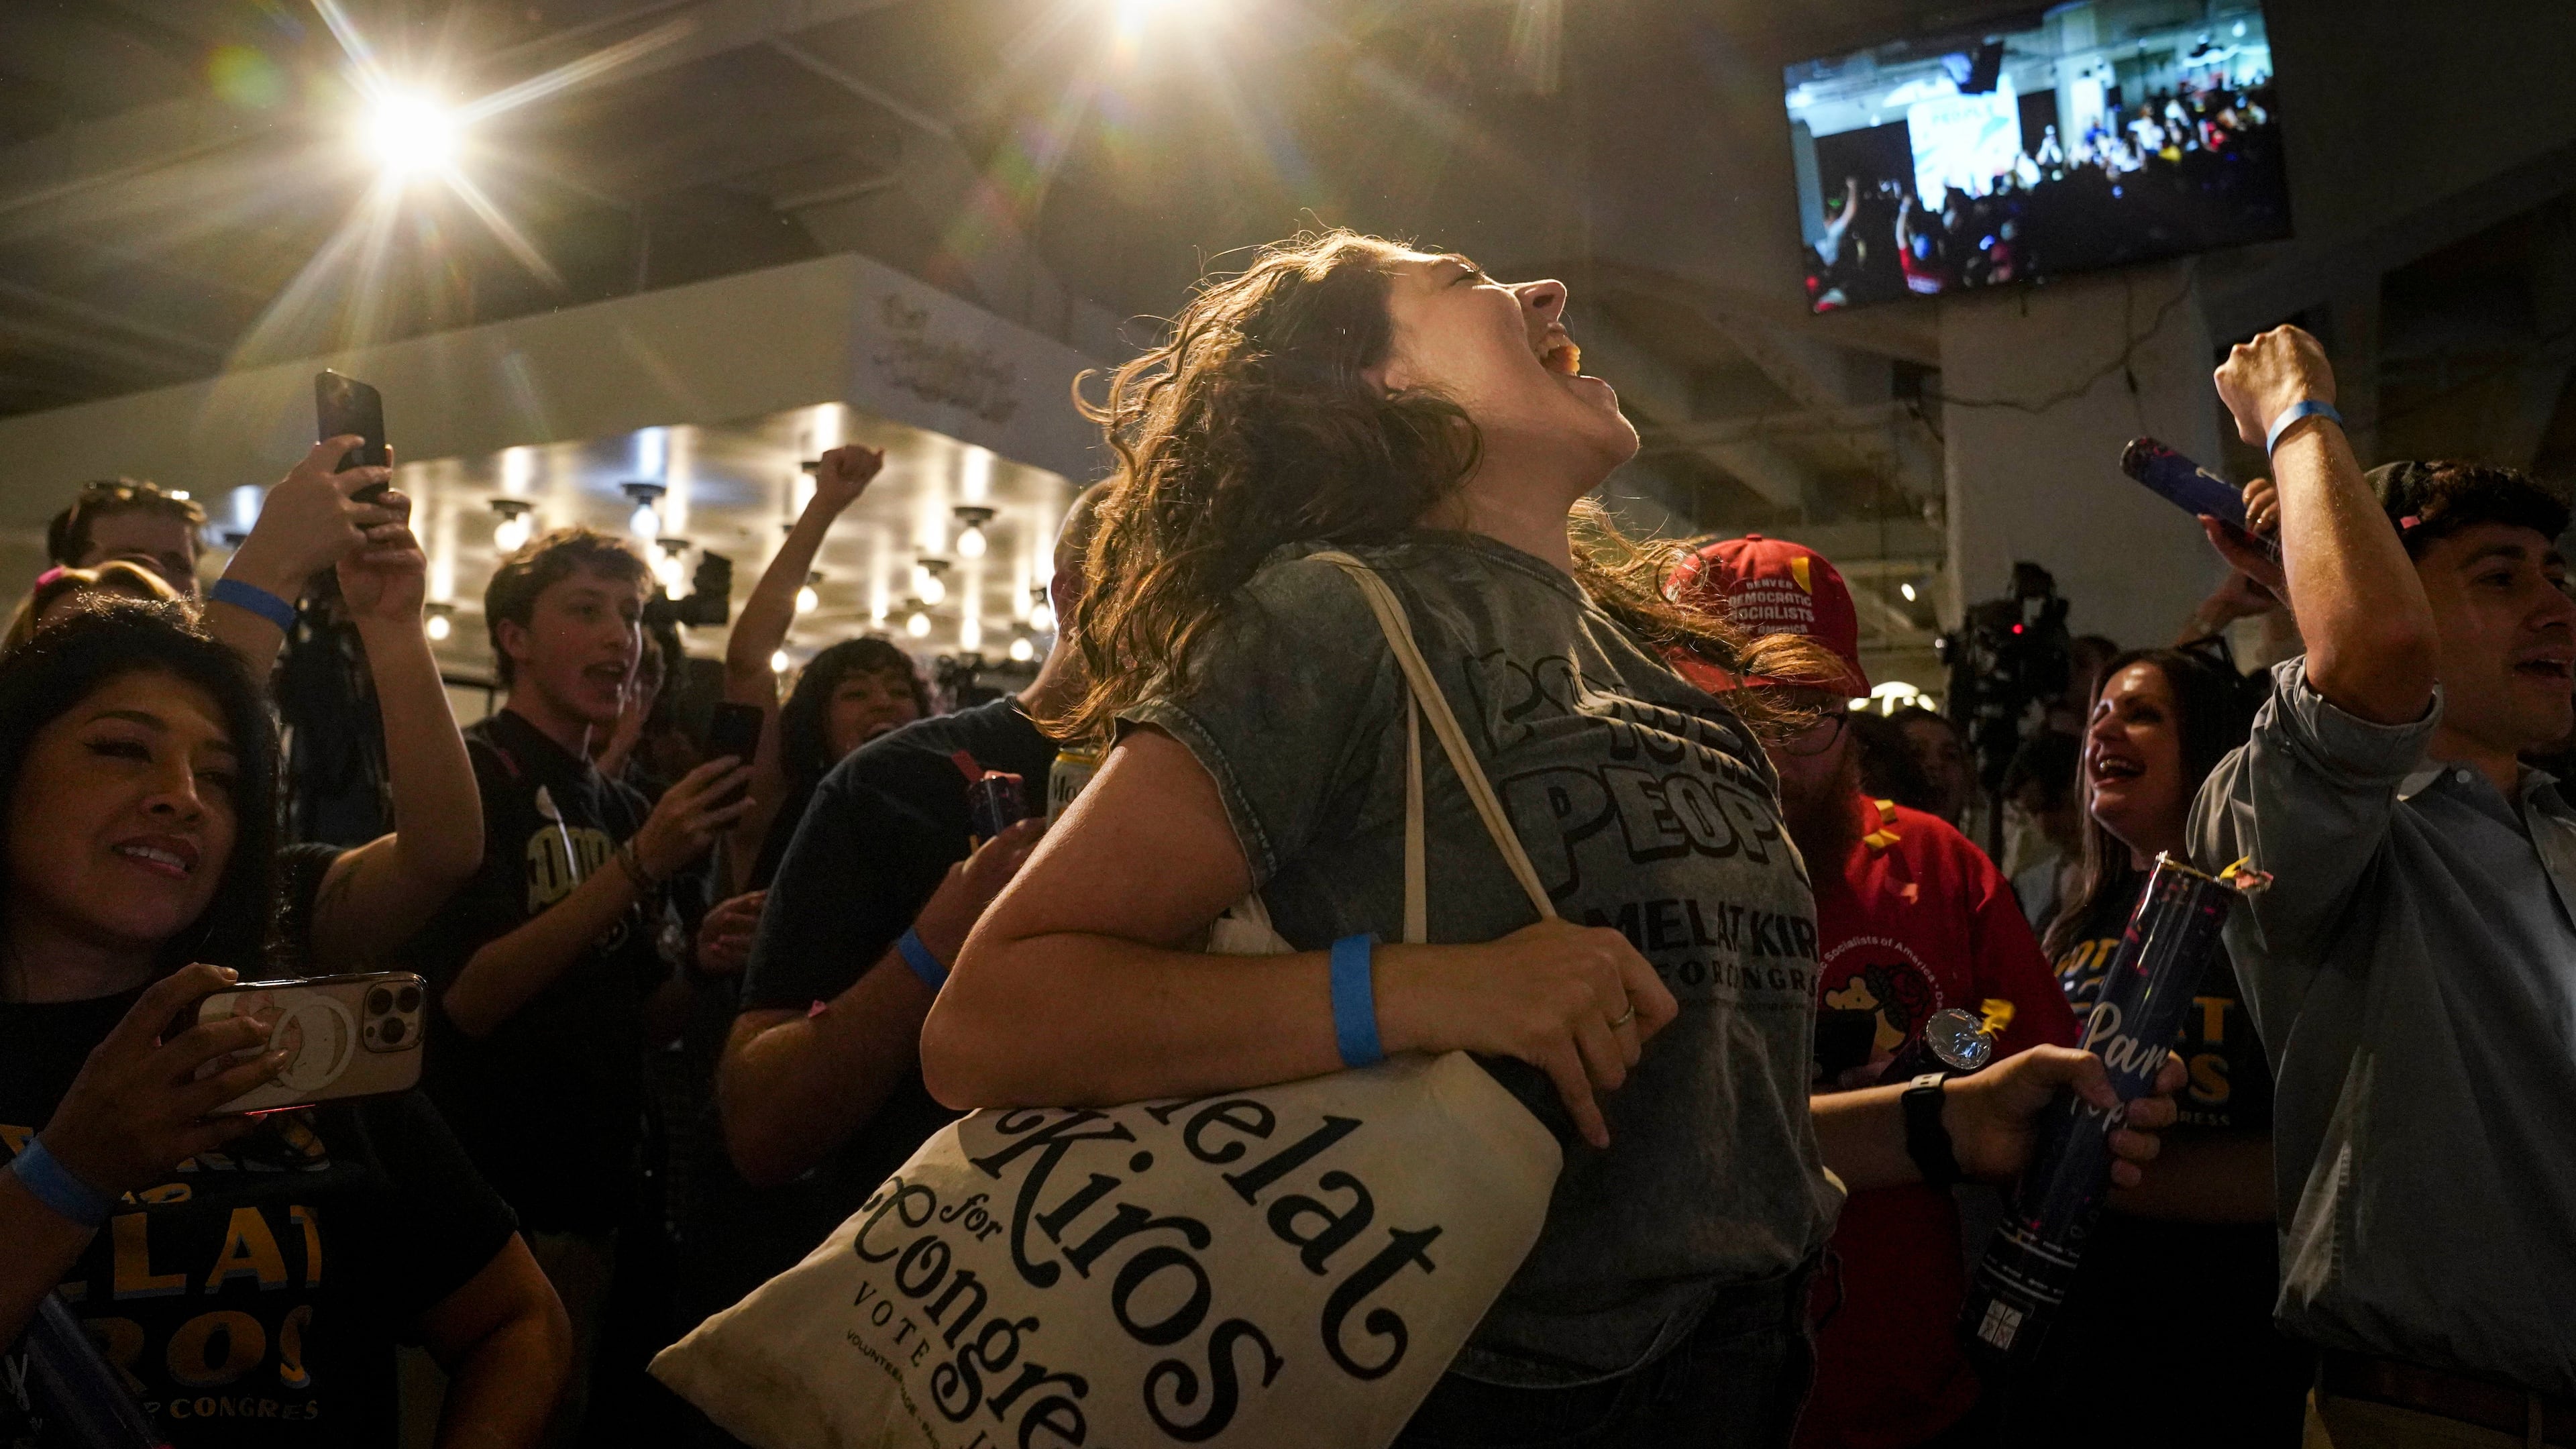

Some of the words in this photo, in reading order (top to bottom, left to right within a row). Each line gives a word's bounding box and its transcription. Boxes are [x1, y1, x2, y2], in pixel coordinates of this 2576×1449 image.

[1729, 591, 1812, 606] DEMOCRATIC
[1746, 579, 1793, 590] DENVER
[1824, 936, 1878, 963] Socialists
[1880, 937, 1893, 948] of
[1894, 941, 1935, 983] America
[939, 1193, 1002, 1242] for
[1144, 1099, 1442, 1381] elat
[58, 1204, 322, 1300] LAT
[969, 1107, 1283, 1442] Kiros
[854, 1281, 930, 1367] VOTE
